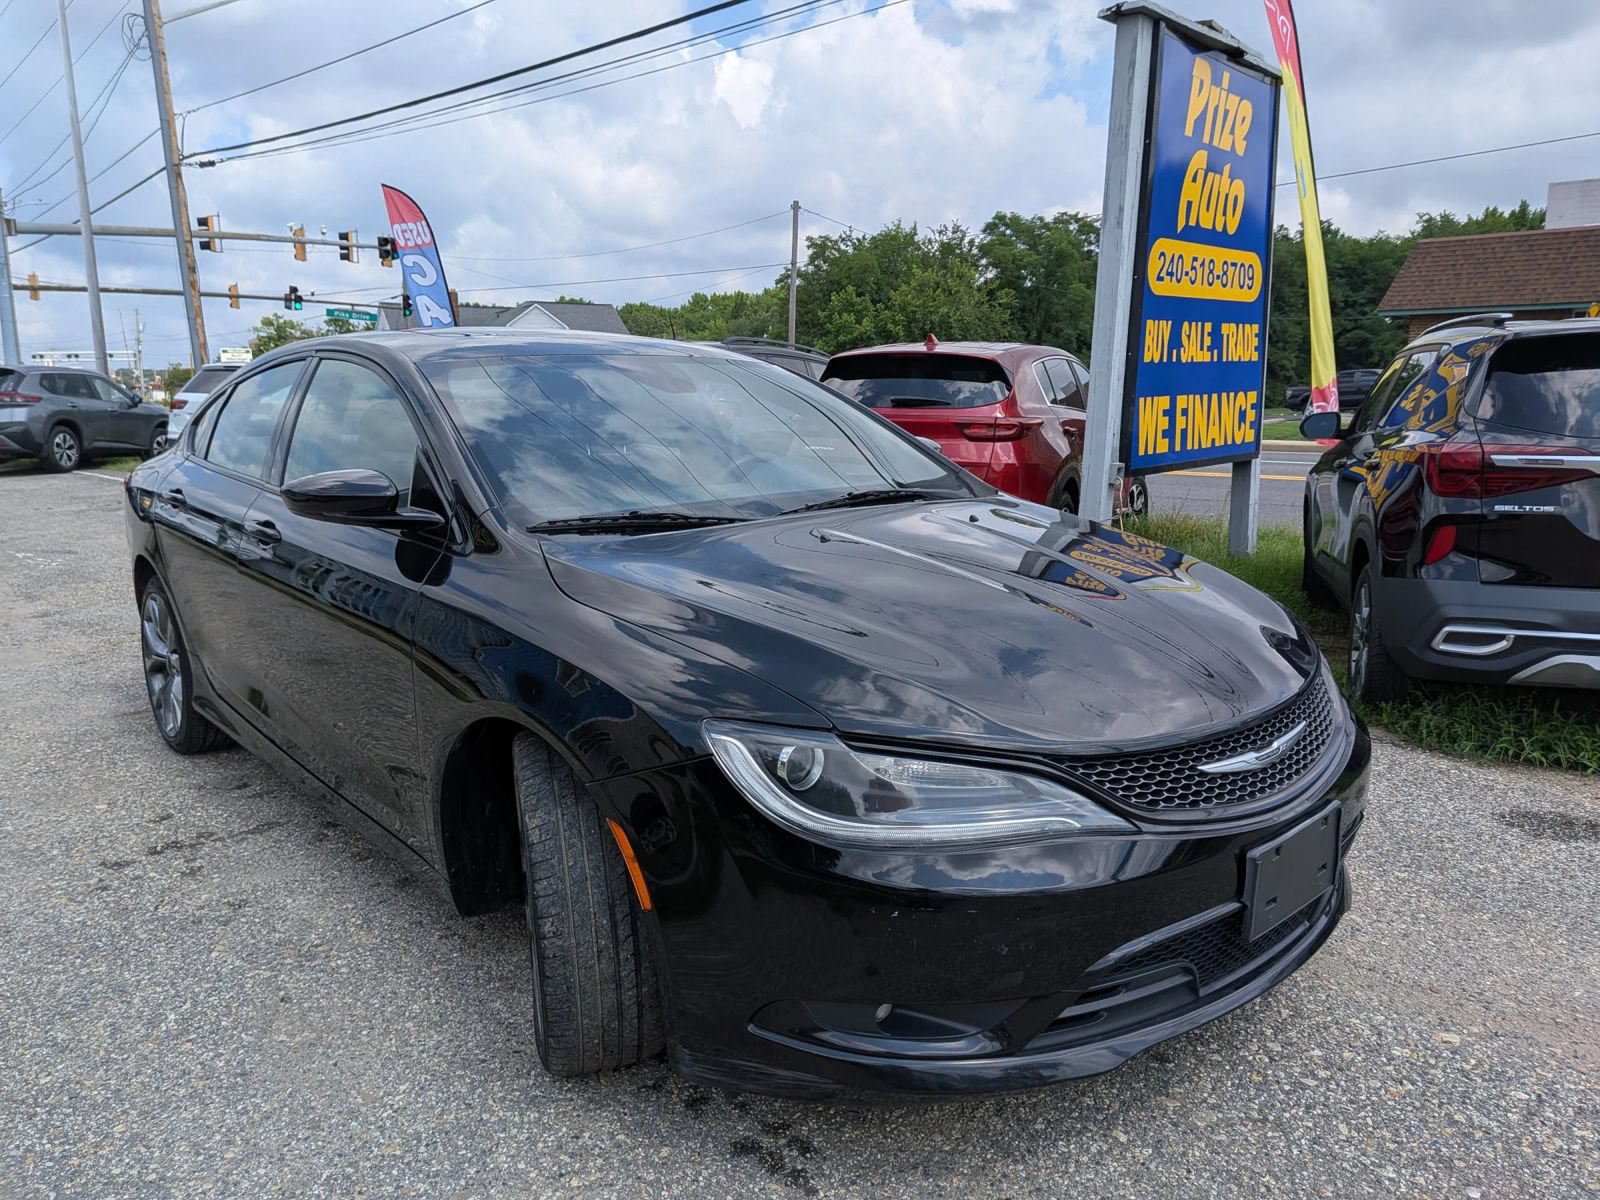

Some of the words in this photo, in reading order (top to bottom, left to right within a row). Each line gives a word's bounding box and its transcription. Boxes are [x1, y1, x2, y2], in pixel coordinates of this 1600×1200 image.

[1184, 57, 1253, 157] Prize
[1177, 149, 1245, 236] Auto
[1156, 251, 1255, 290] 240-518-8709
[352, 311, 370, 320] Drive
[1143, 319, 1172, 363] BUY
[1180, 321, 1212, 363] SALE
[1221, 323, 1259, 362] TRADE
[1138, 395, 1170, 456] WE
[1175, 391, 1257, 452] FINANCE
